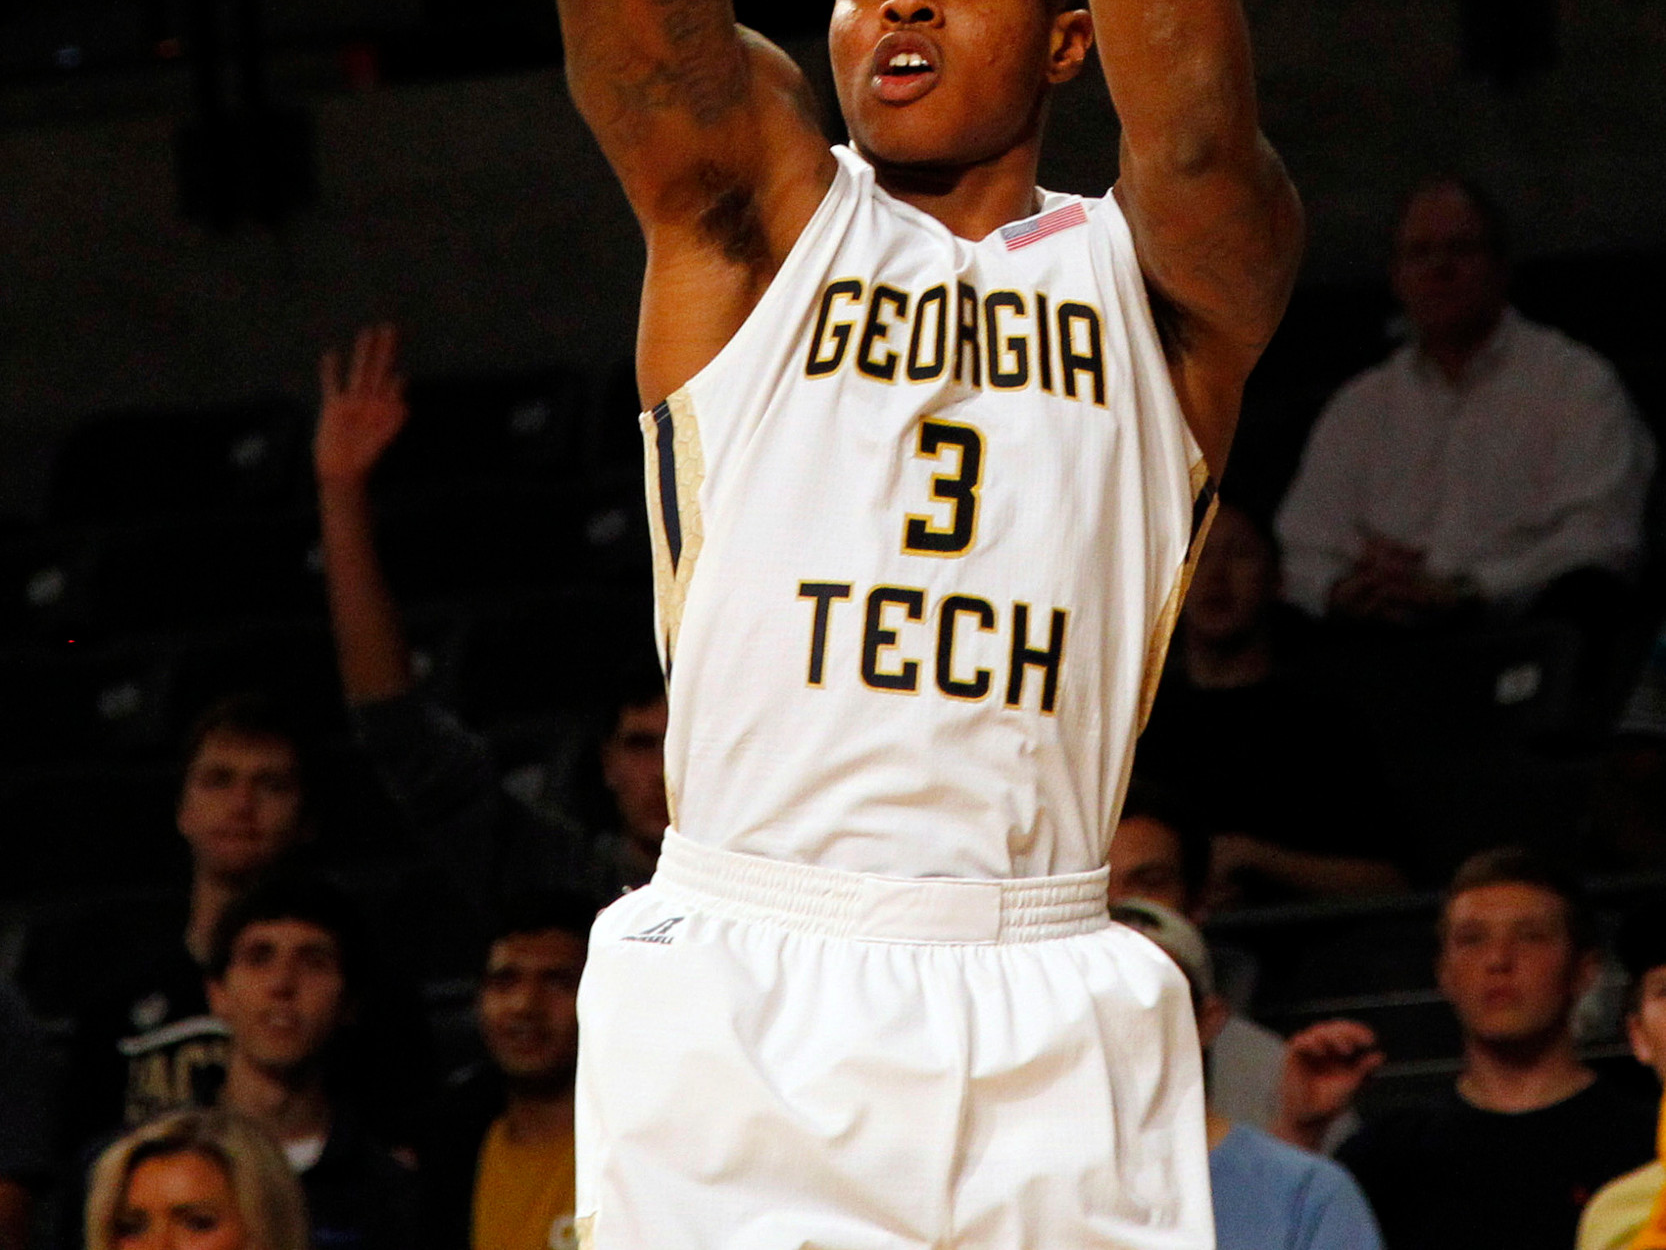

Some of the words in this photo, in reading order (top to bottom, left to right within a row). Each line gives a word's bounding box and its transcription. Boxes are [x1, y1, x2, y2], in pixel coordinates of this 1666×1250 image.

[804, 278, 1109, 409] GEORGIA
[901, 417, 987, 558] 3
[796, 580, 1069, 717] TECH
